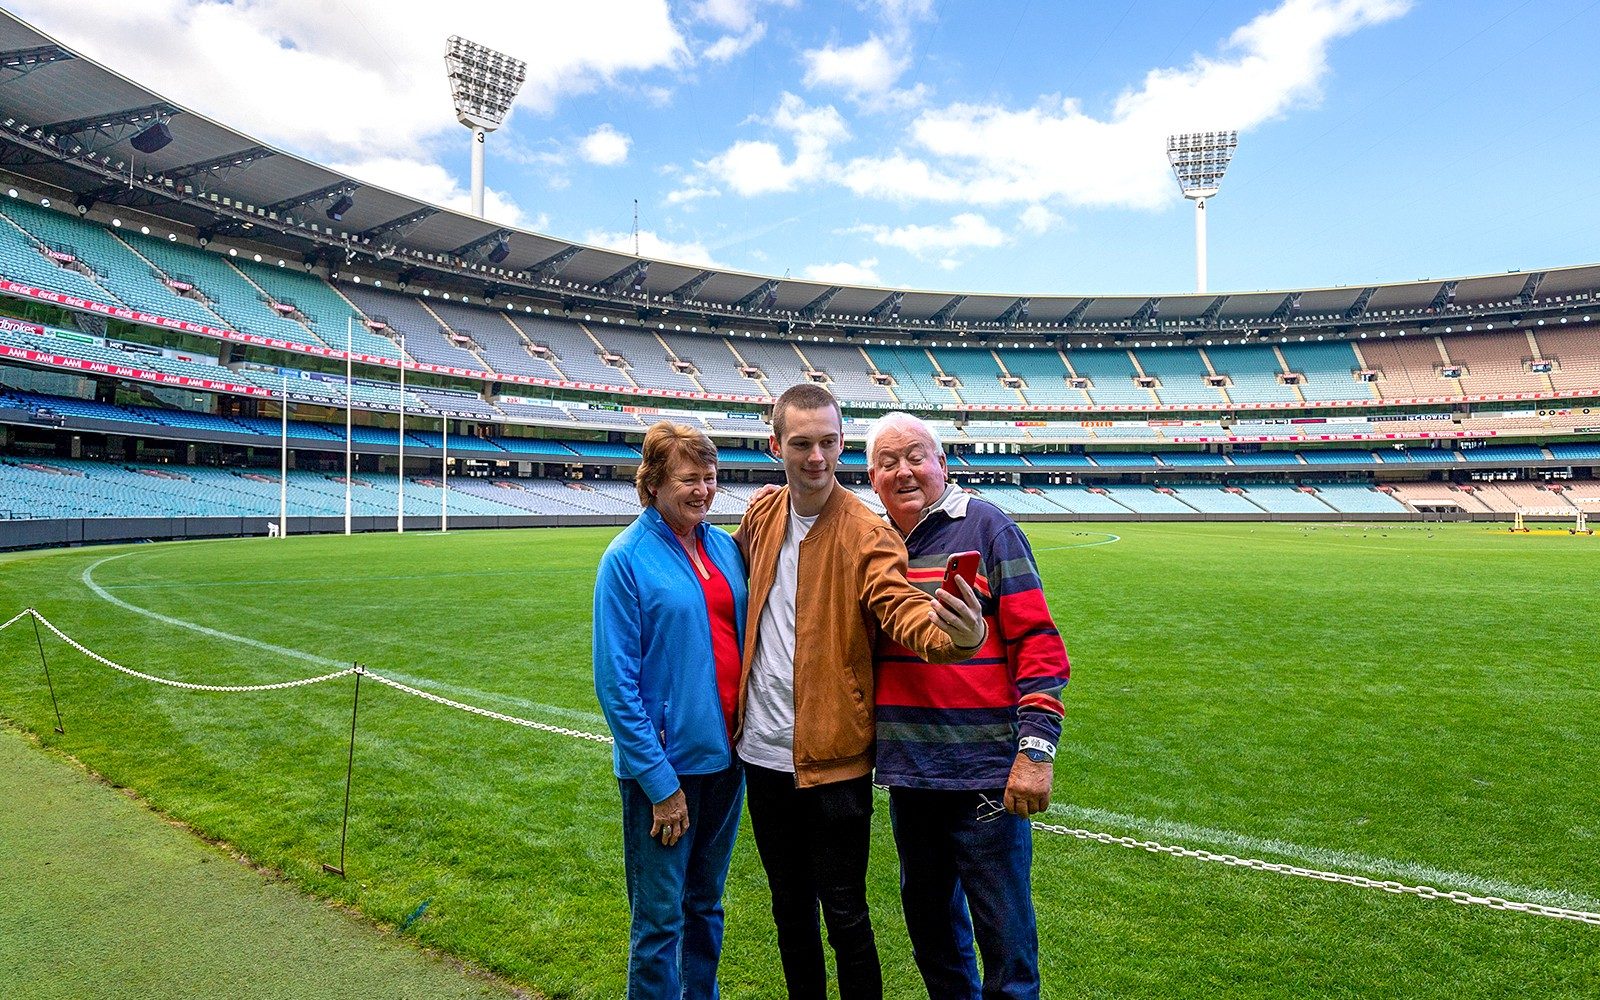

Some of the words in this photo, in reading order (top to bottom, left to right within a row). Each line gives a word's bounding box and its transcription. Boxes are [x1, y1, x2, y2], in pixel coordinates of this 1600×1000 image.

[478, 132, 484, 143] 3
[1198, 201, 1204, 210] 4
[8, 348, 27, 358] AAMI
[36, 353, 54, 363] AAMI
[879, 402, 906, 410] WARNE
